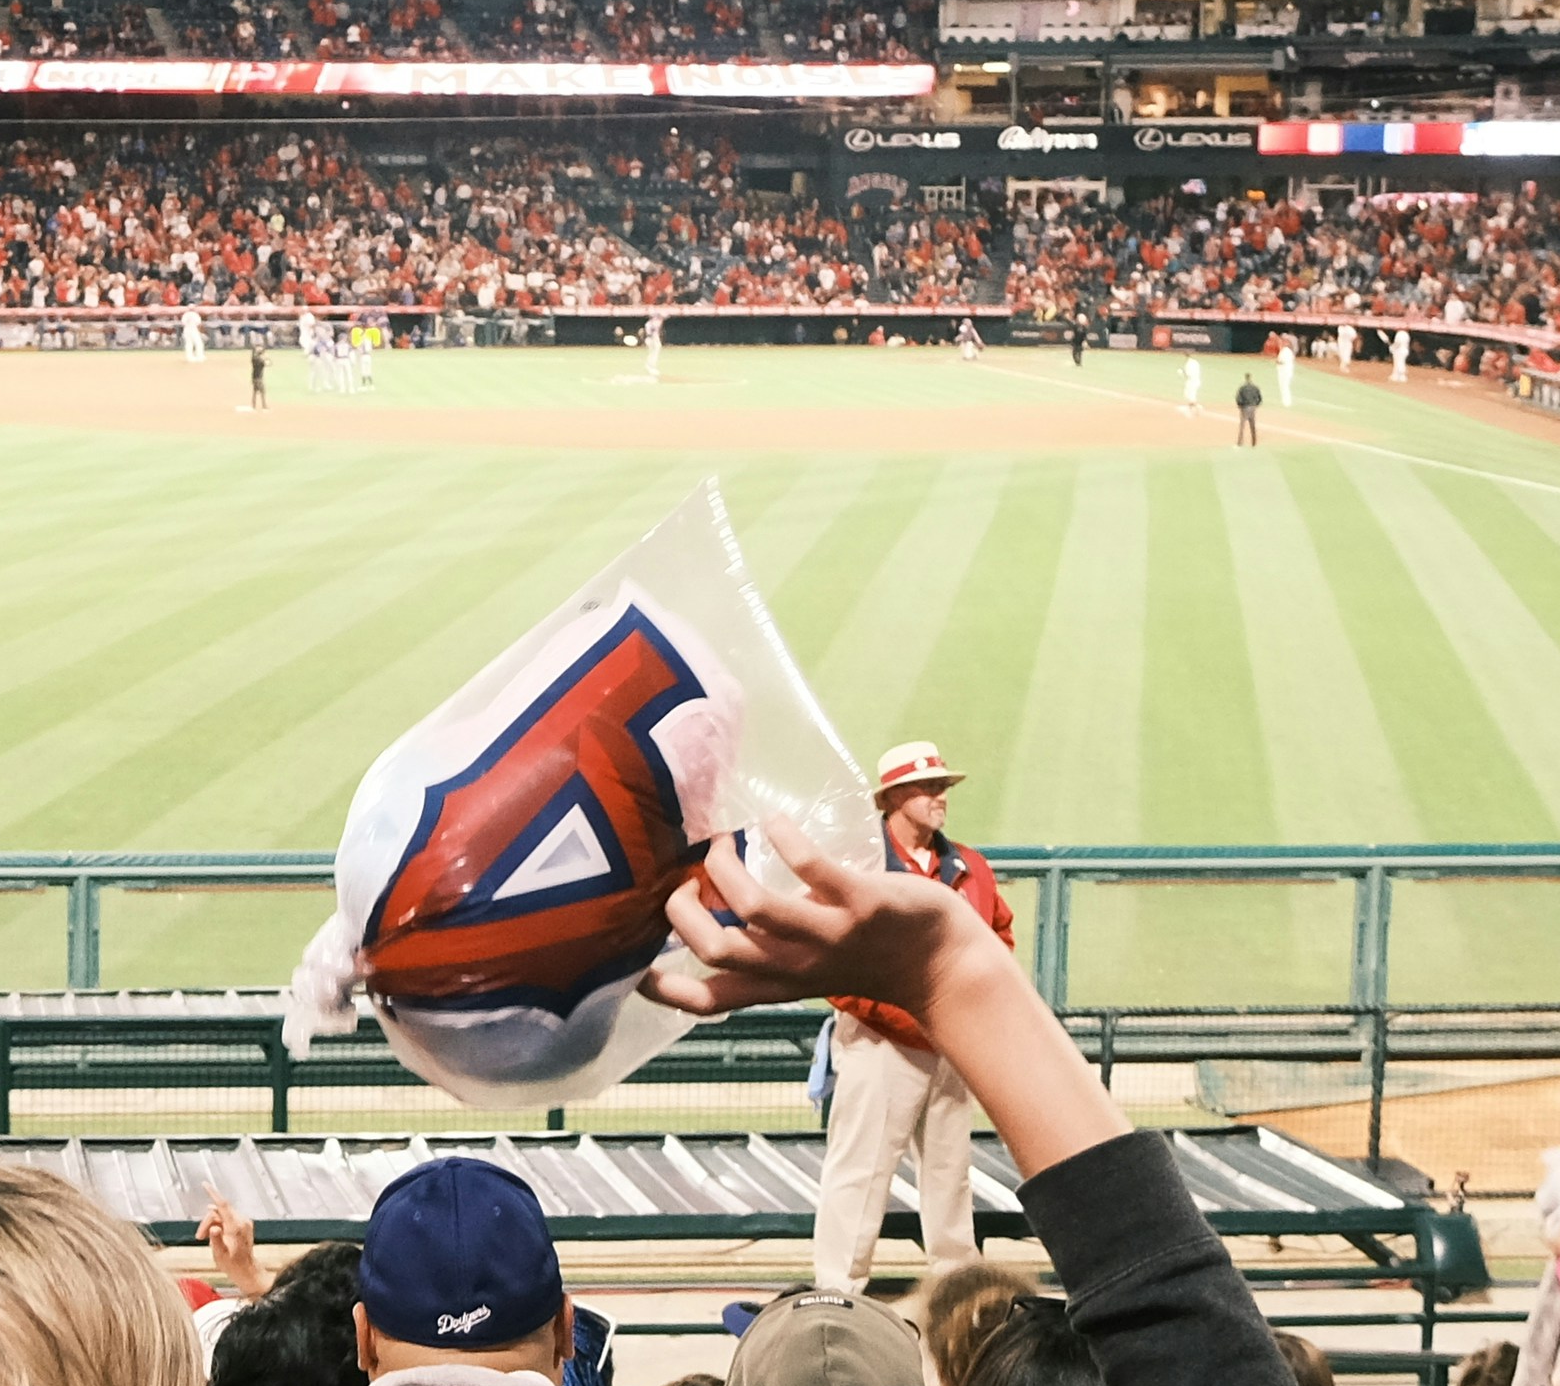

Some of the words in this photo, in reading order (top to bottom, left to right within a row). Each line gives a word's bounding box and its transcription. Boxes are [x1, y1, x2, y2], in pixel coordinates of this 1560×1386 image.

[877, 130, 961, 149] LEXUS
[1166, 131, 1252, 148] LEXUS
[437, 1303, 492, 1335] Dodgers
